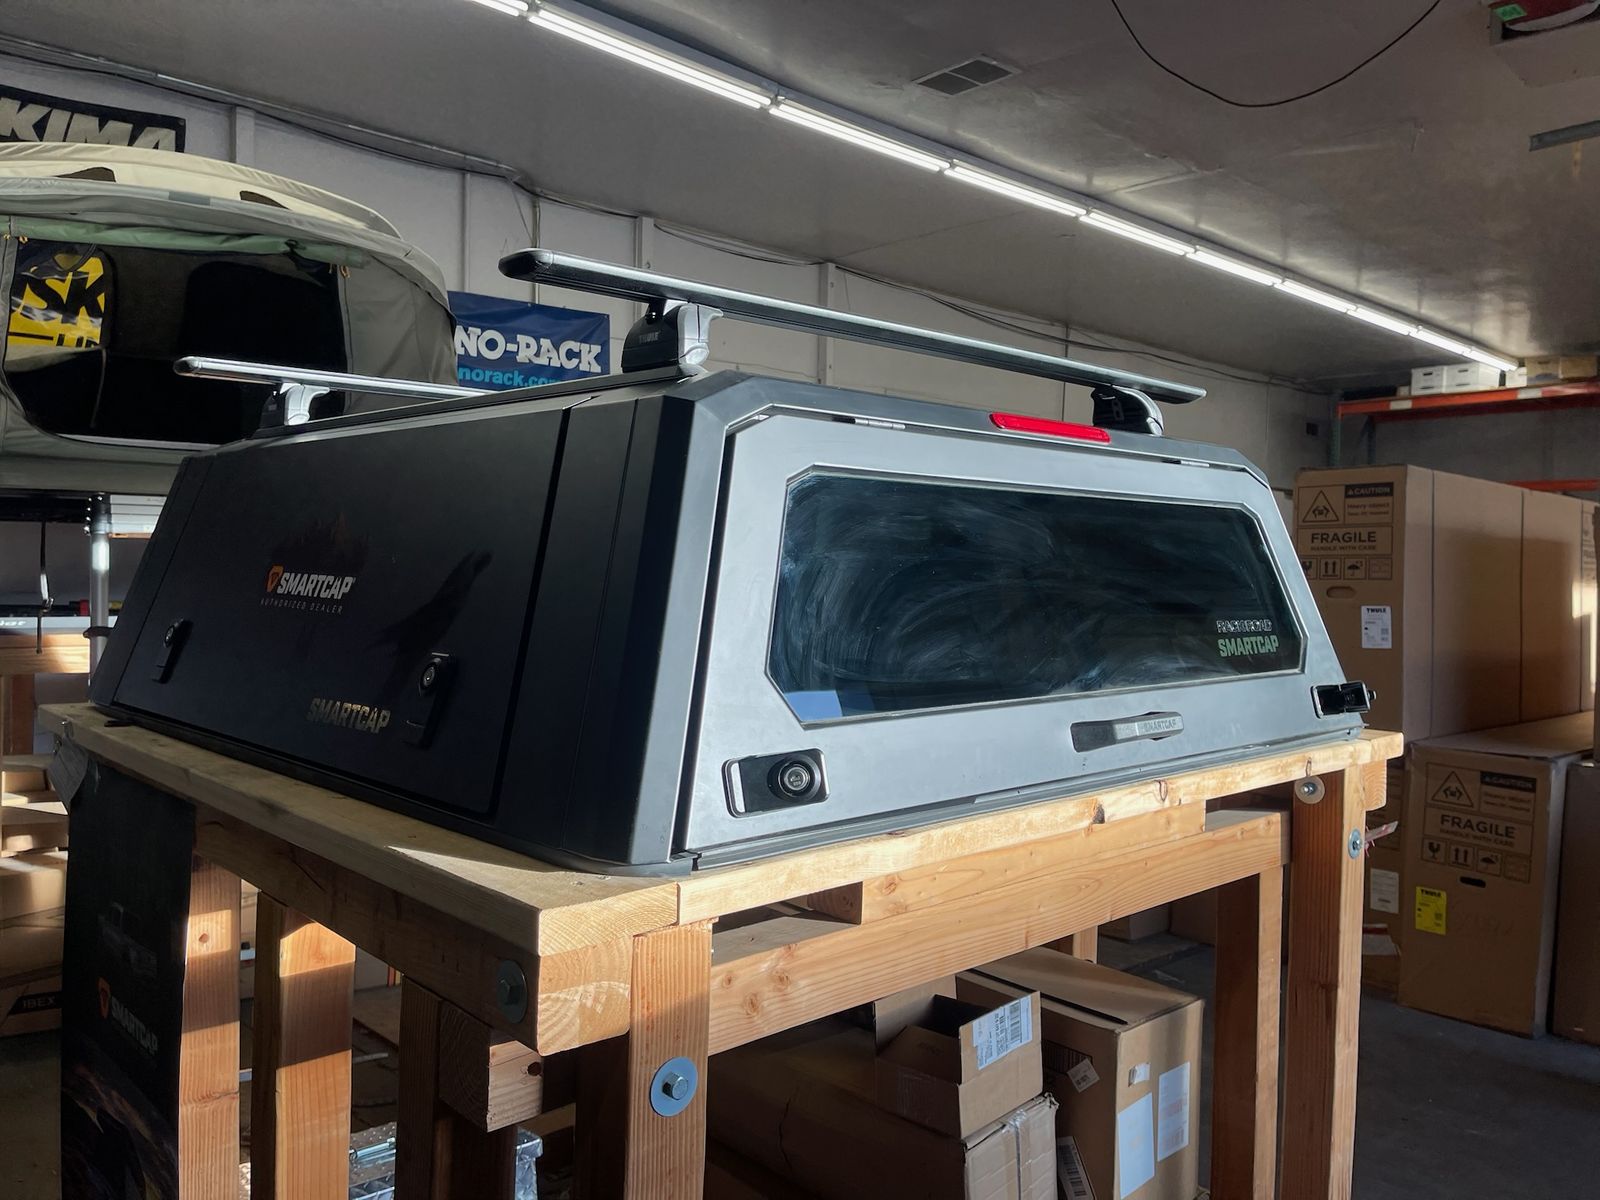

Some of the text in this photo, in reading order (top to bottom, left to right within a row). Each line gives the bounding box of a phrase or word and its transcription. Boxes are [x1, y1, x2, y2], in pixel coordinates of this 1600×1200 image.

[454, 324, 602, 374] NO-RACK
[458, 366, 561, 387] norack.co
[1353, 486, 1391, 496] CAUTION
[1311, 532, 1377, 544] FRAGILE
[277, 572, 354, 600] SMARTCAP
[260, 598, 344, 615] AUTHORIZED DEALER
[1217, 635, 1279, 657] SMARTCAP
[305, 698, 391, 734] SMARTCAP
[1440, 814, 1517, 840] FRAGILE
